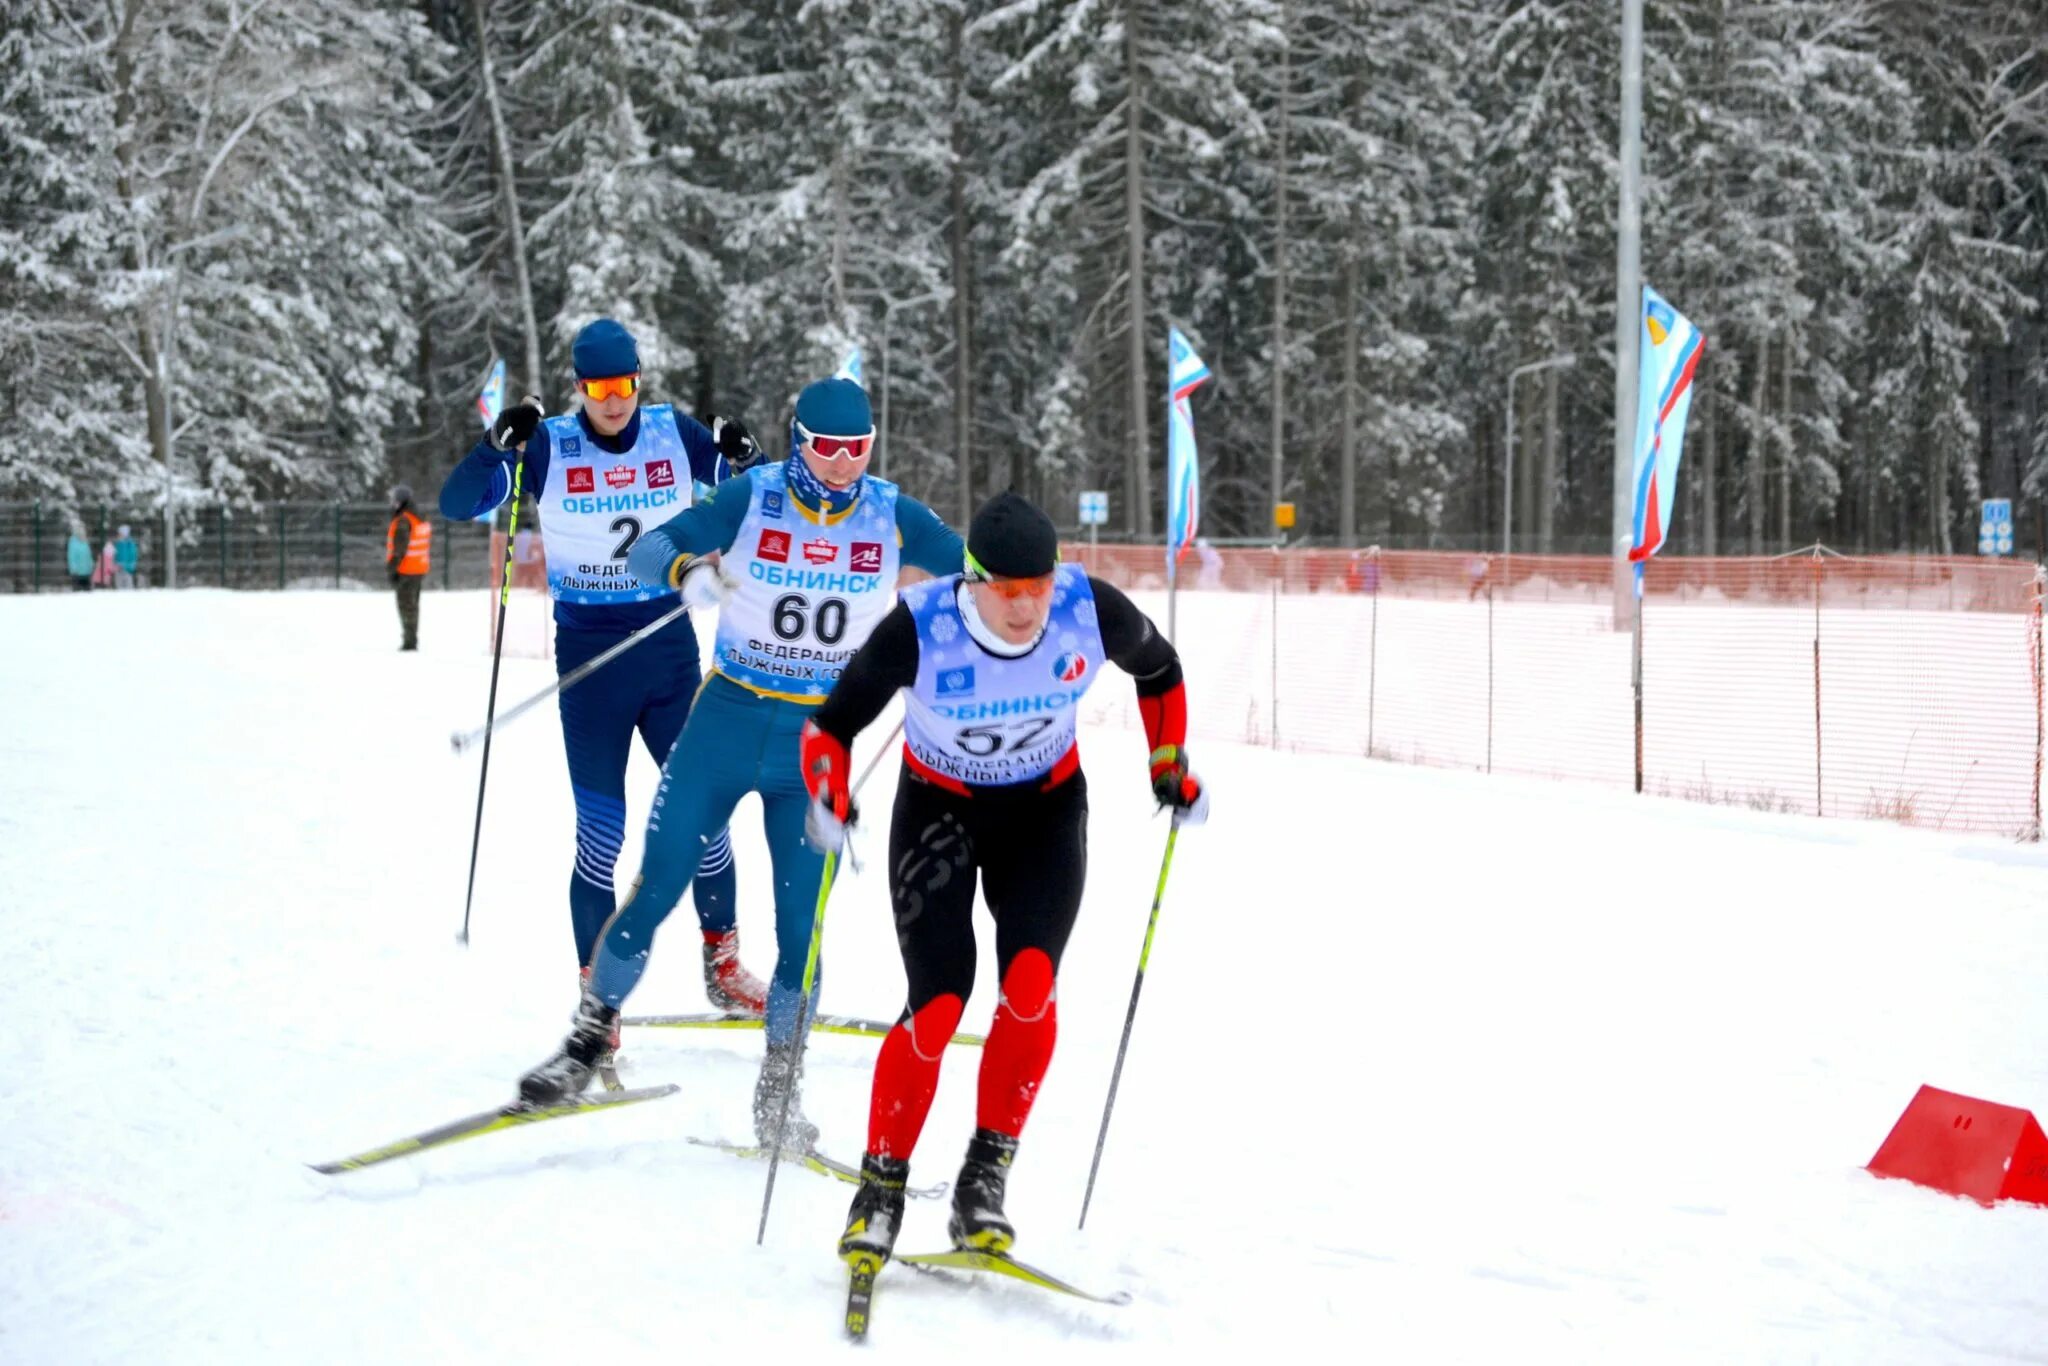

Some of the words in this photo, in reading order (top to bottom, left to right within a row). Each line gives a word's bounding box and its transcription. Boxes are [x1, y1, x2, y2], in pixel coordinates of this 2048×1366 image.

[562, 487, 678, 514] ОБНИНСК
[609, 514, 643, 561] 2
[562, 576, 640, 590] ЛЫЖНЫХ
[749, 561, 883, 593] ОБНИНСК
[771, 592, 850, 647] 60
[954, 717, 1055, 756] 52
